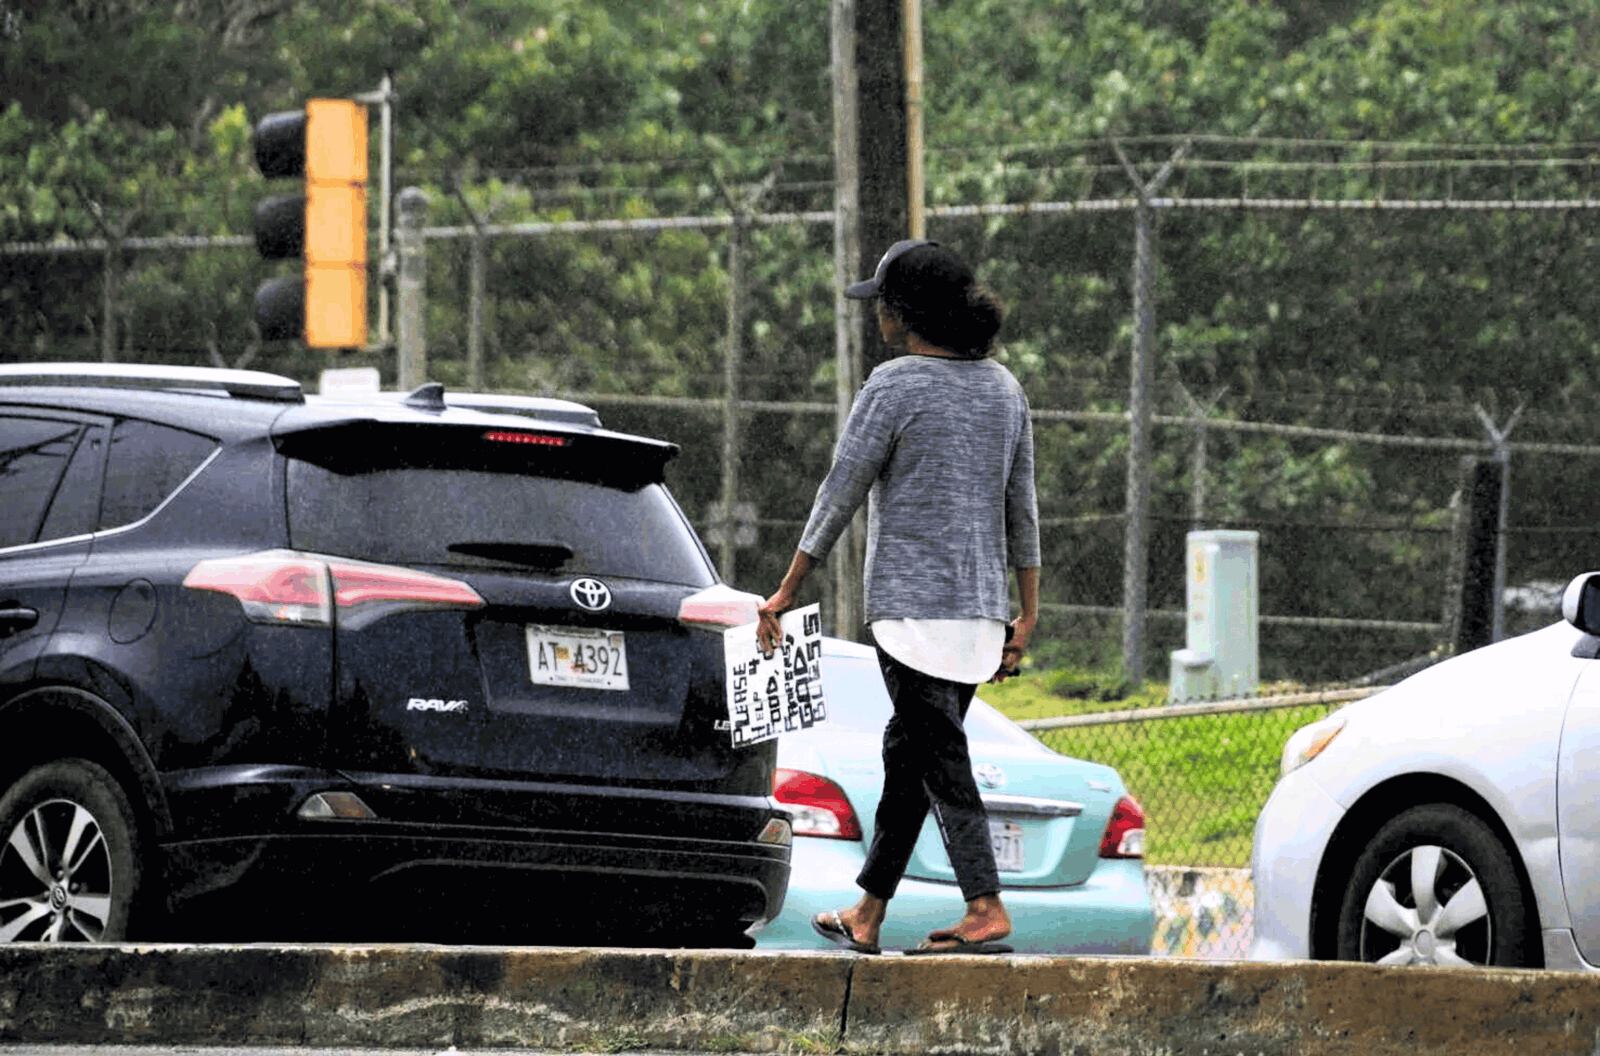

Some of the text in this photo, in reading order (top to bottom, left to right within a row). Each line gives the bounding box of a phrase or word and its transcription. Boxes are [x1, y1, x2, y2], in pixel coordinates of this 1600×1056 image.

[538, 641, 623, 676] AT 4392
[793, 646, 814, 729] GOD
[803, 612, 827, 722] BLESS
[406, 698, 469, 714] RAV4
[732, 662, 751, 746] PLEASE
[751, 691, 766, 742] HELP
